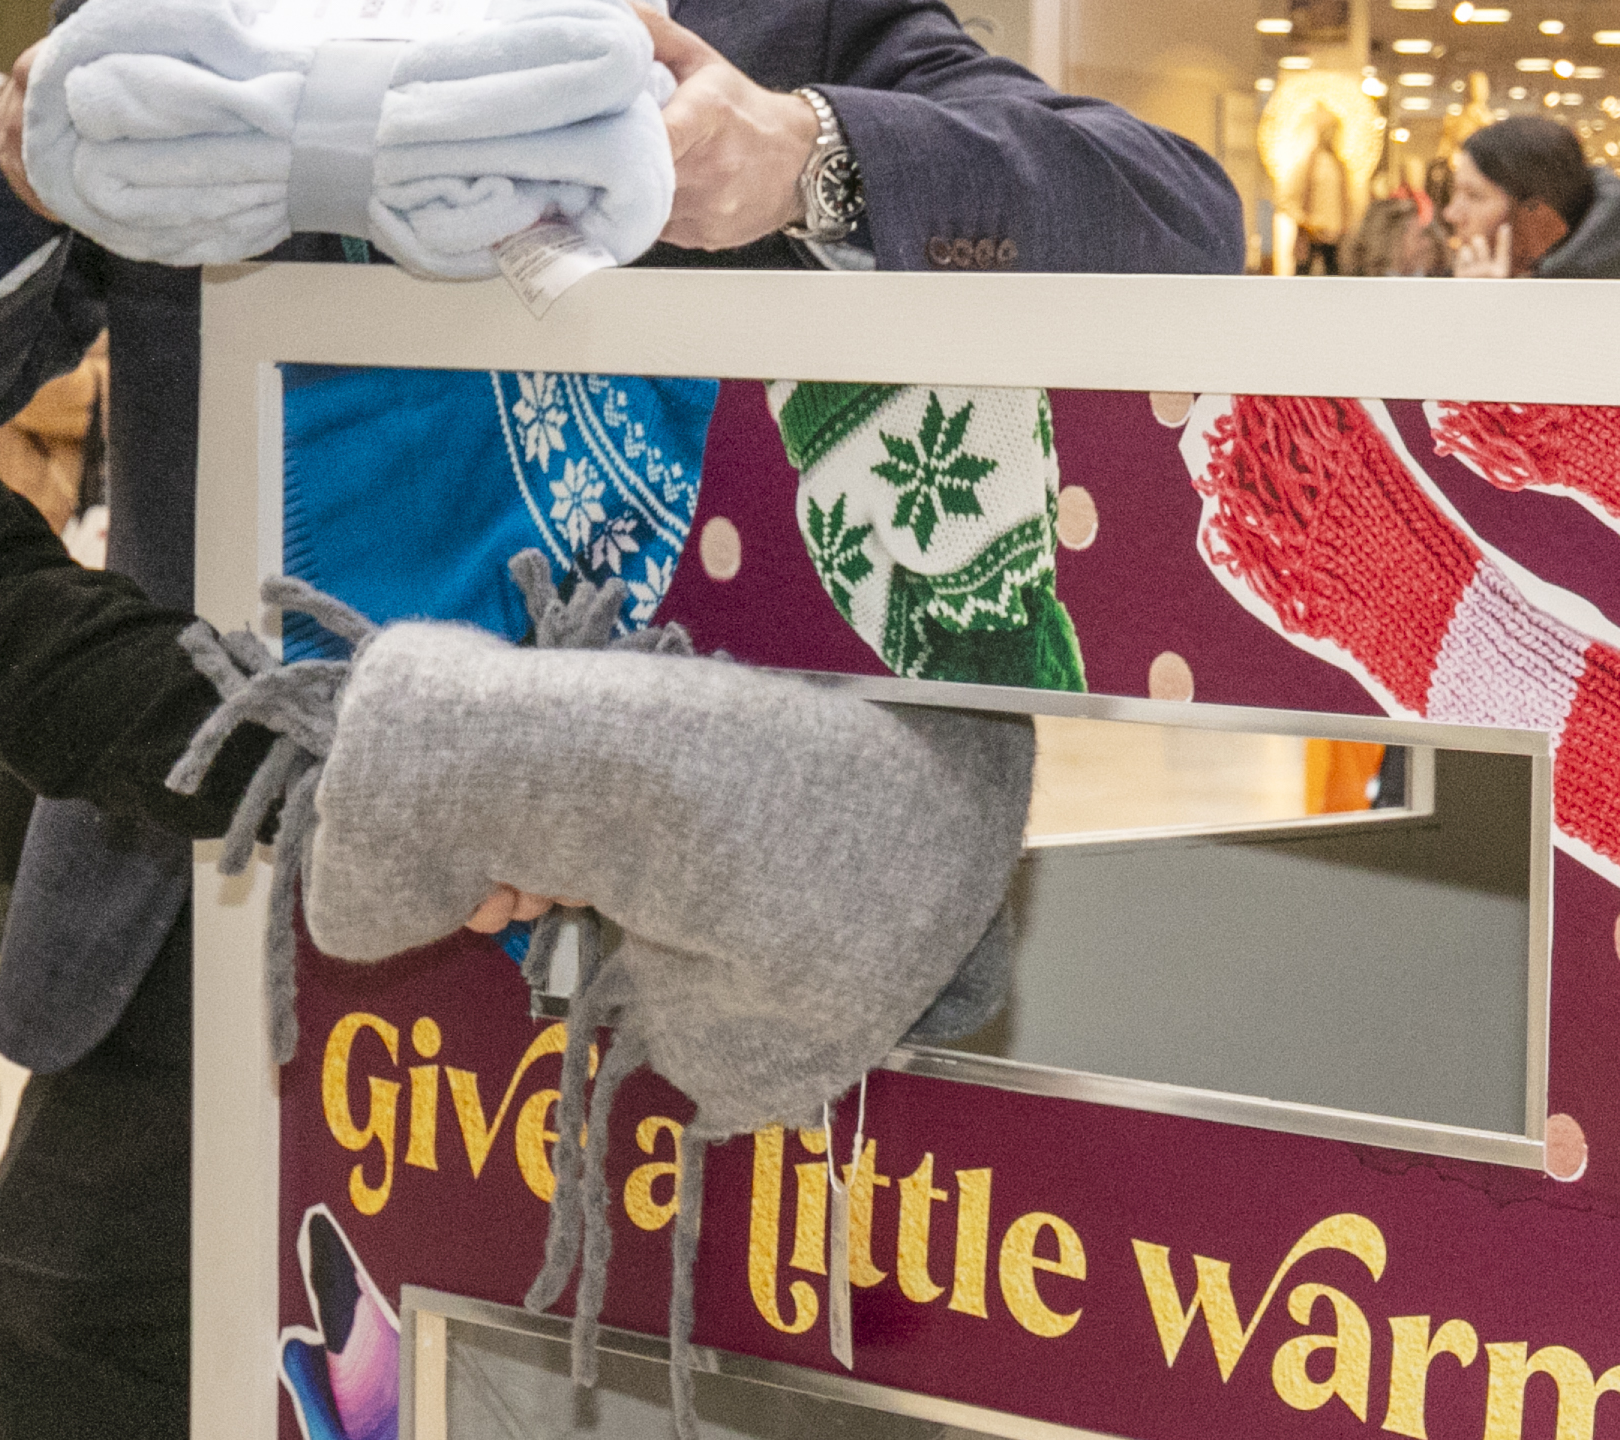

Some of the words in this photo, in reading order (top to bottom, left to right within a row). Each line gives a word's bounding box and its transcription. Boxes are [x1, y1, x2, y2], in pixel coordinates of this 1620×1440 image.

[322, 1011, 599, 1216] Give
[623, 1115, 701, 1231] a
[748, 1122, 1088, 1339] little
